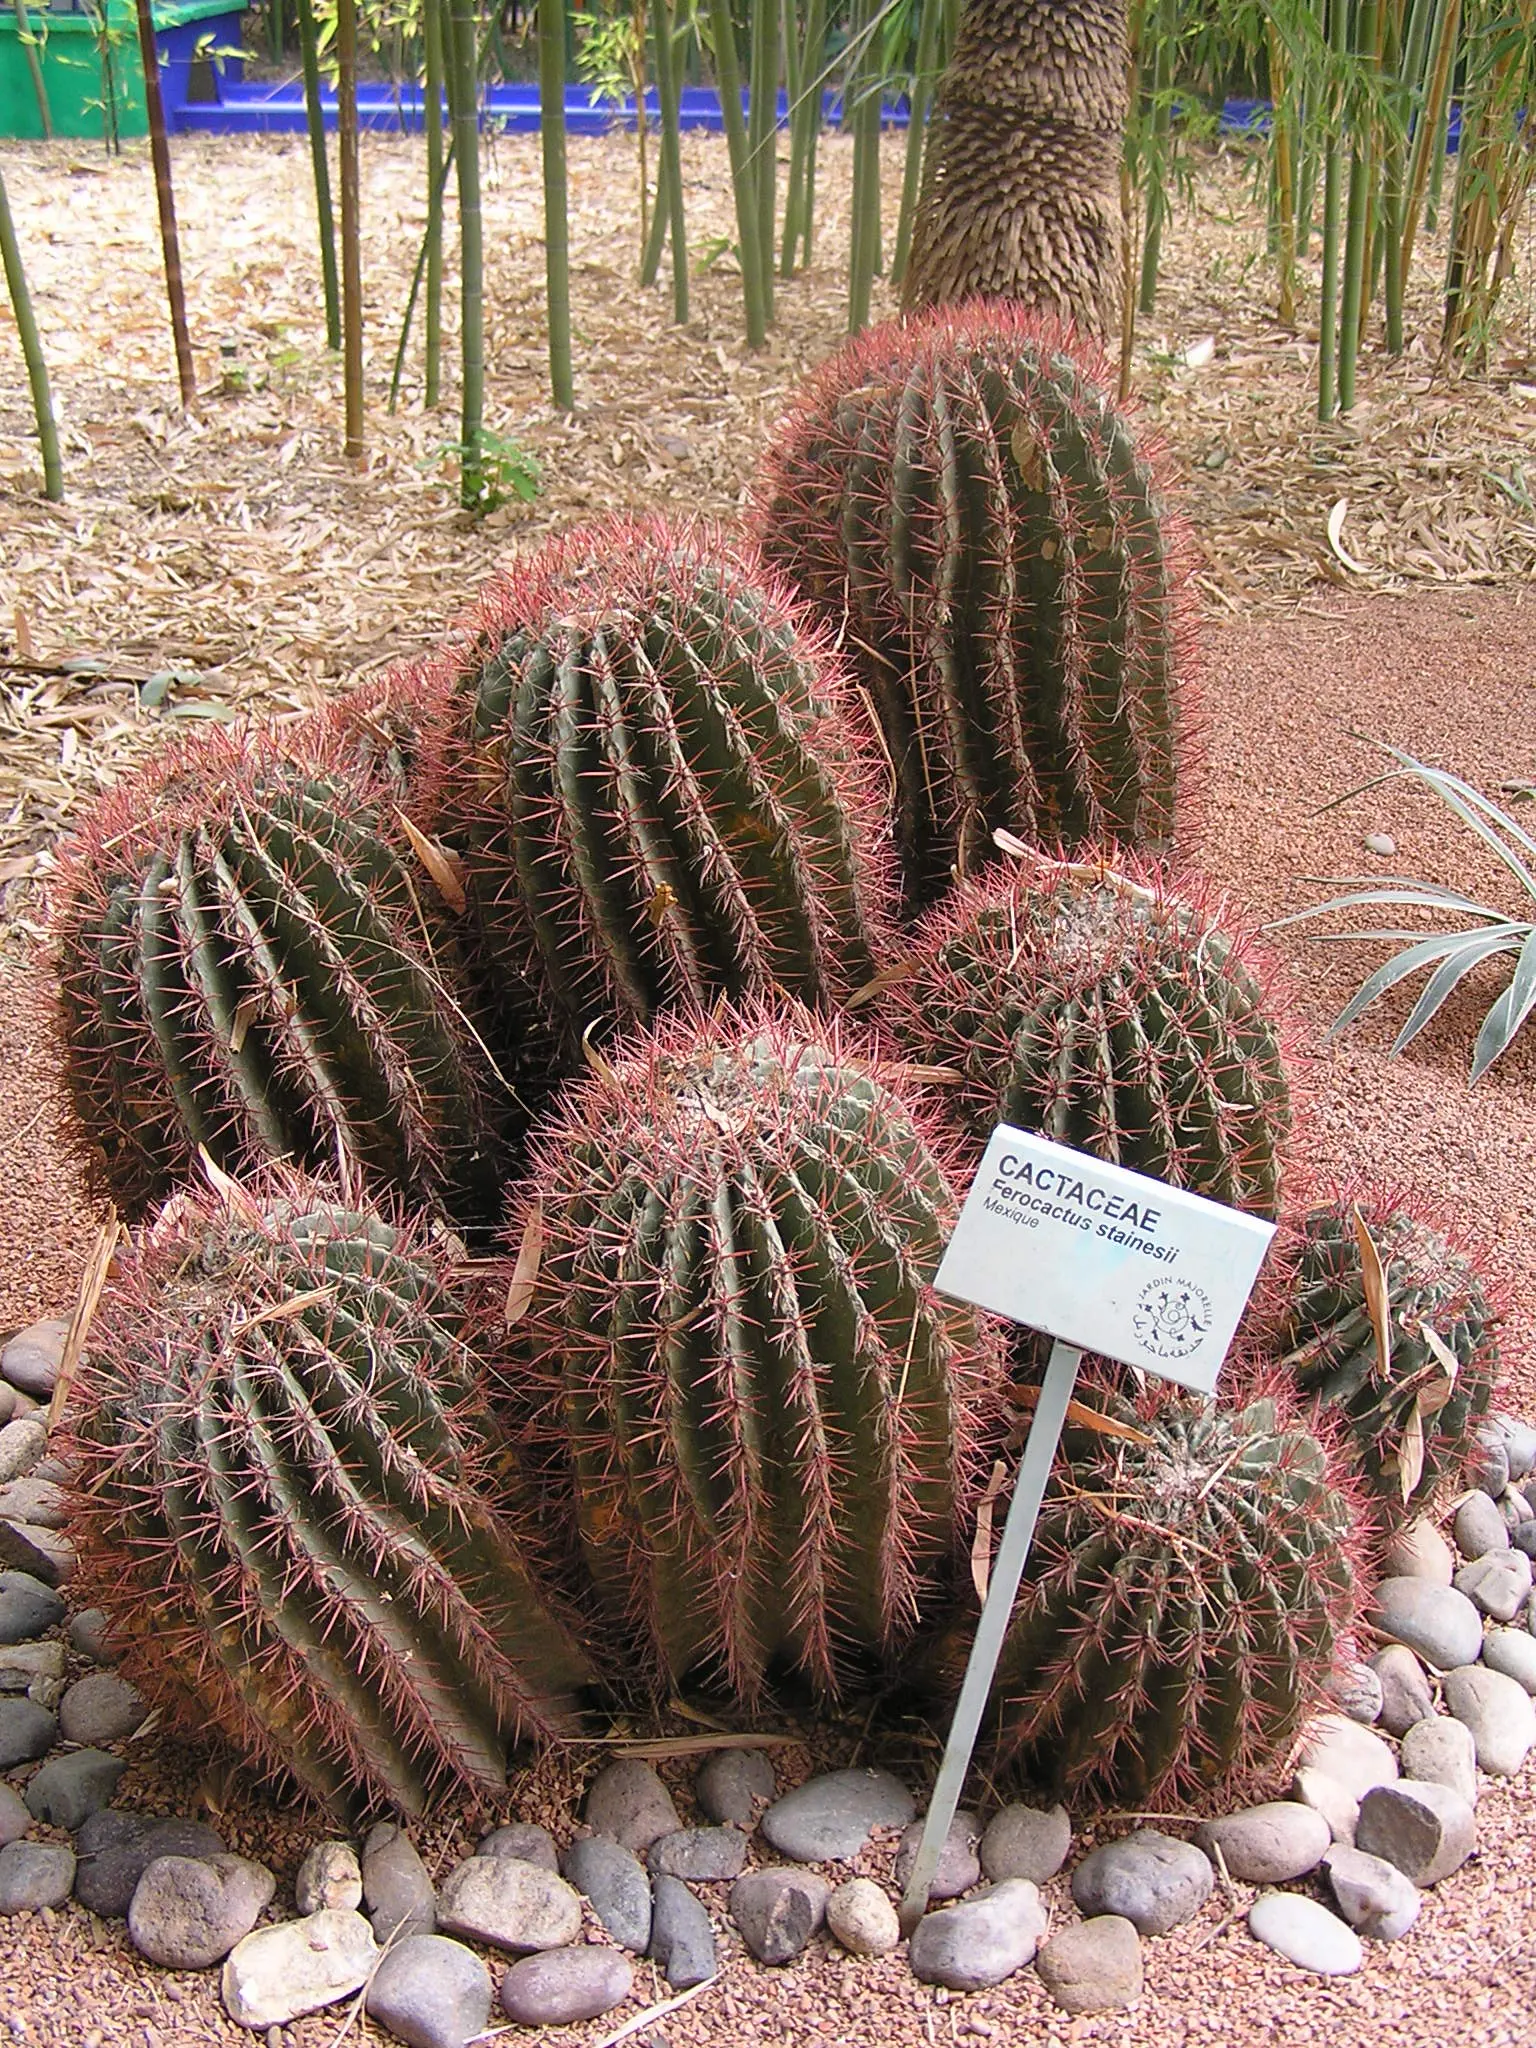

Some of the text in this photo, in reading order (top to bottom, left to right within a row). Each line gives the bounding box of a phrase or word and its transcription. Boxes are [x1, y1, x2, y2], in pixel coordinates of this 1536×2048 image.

[982, 1196, 1040, 1229] Mexique
[991, 1178, 1180, 1264] Ferocactus stainesii
[998, 1154, 1162, 1233] CACTACEAE
[1138, 1276, 1213, 1326] JARDIN MAJORELLE
